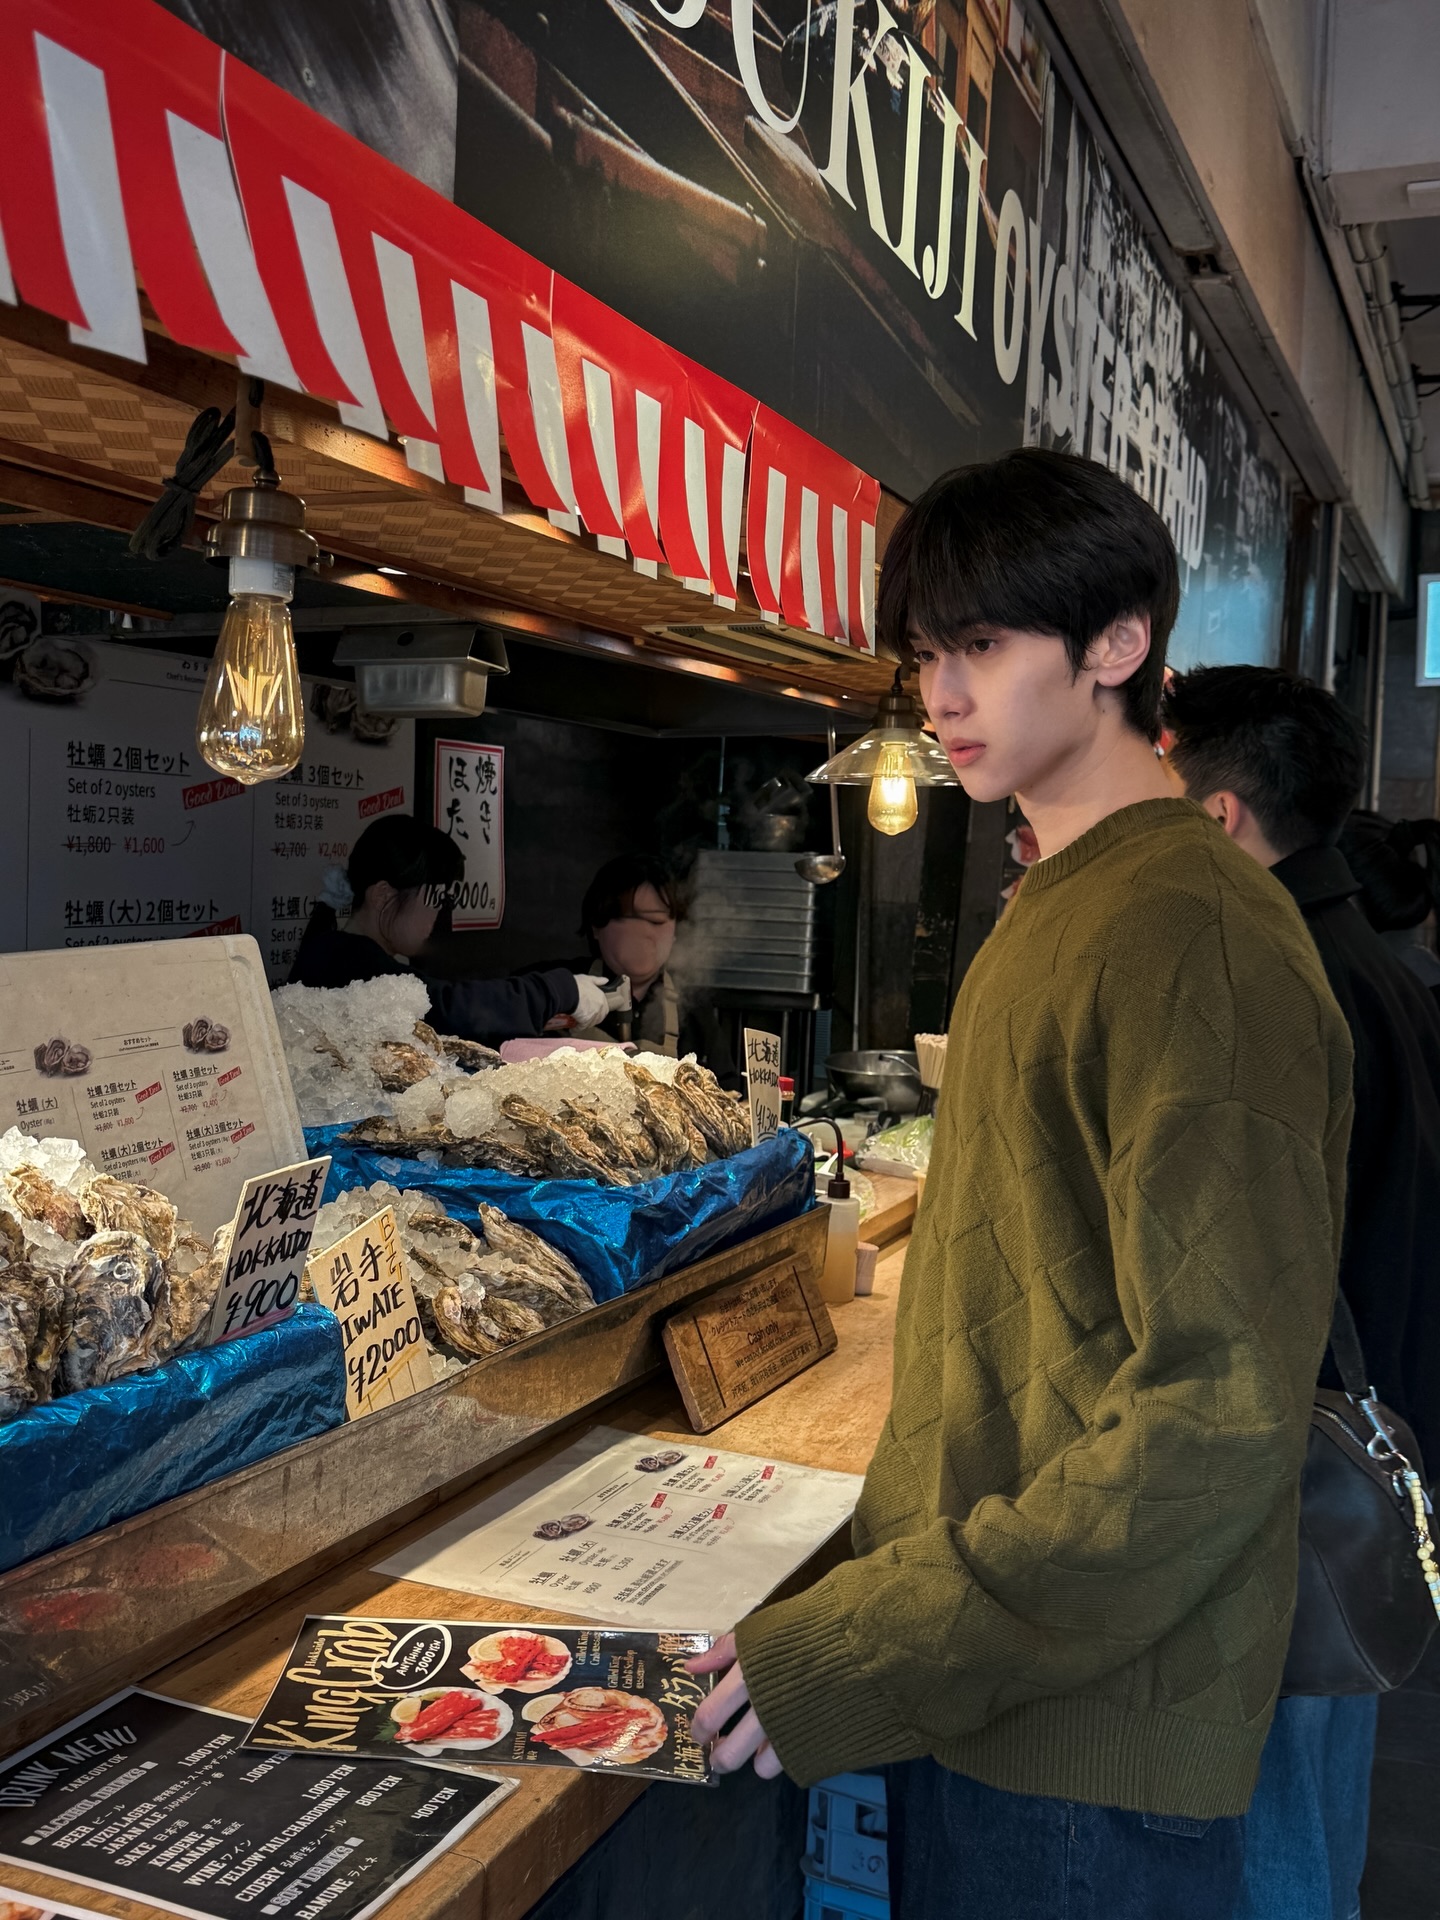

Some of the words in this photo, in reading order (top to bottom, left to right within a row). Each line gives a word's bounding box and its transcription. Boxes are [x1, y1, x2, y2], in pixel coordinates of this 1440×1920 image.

[67, 741, 105, 768] 牡蠣
[113, 746, 190, 773] 2個セット
[308, 765, 364, 787] 3個セット
[68, 778, 87, 794] Set
[91, 778, 103, 795] of
[105, 781, 112, 795] 2
[115, 783, 155, 800] oysters
[275, 792, 290, 807] Set
[292, 793, 301, 807] of
[303, 794, 308, 808] 3
[309, 796, 339, 811] oysters
[67, 804, 135, 825] 牡蛎2只装
[67, 836, 111, 856] ¥1,800
[124, 837, 165, 856] ¥1,600
[318, 842, 348, 860] ¥2,400
[748, 1038, 779, 1067] 北海道
[21, 1119, 42, 1131] Oyster
[239, 1166, 324, 1241] 北海道
[226, 1228, 312, 1288] HOKKAIDO
[330, 1238, 384, 1311] 岩手
[223, 1271, 298, 1335] ¥900
[341, 1281, 405, 1351] IWATE
[748, 1327, 766, 1346] Cash
[765, 1320, 780, 1335] only
[348, 1317, 420, 1404] ¥2000
[286, 1622, 397, 1687] Crab
[304, 1638, 325, 1666] Hokkaido
[397, 1642, 424, 1676] ANYTHING
[576, 1646, 587, 1664] Grilled
[252, 1689, 408, 1751] King
[51, 1725, 139, 1777] MENU
[60, 1775, 94, 1792] TAKE
[88, 1762, 113, 1776] OUT
[108, 1754, 128, 1763] OK
[35, 1799, 102, 1838] ALCOHOL
[91, 1768, 146, 1799] DRINKS
[52, 1826, 94, 1848] BEER
[92, 1804, 125, 1824] ビール
[178, 1749, 212, 1766] 1,000
[204, 1734, 234, 1748] YEN
[82, 1826, 120, 1847] YUZU
[113, 1803, 156, 1827] LAGER
[103, 1827, 146, 1854] JAPAN
[140, 1812, 167, 1828] ALE
[115, 1842, 156, 1866] SAKE
[153, 1820, 189, 1841] 日本酒
[240, 1764, 274, 1782] 1,000
[184, 1860, 226, 1885] WINE
[220, 1840, 251, 1860] ワイン
[302, 1780, 335, 1799] 1,000
[326, 1765, 356, 1780] YEN
[215, 1852, 266, 1886] YELLOW
[258, 1837, 290, 1852] TAIL
[282, 1788, 350, 1836] CHARDONNAY
[149, 1832, 204, 1866] KINOENE
[167, 1837, 223, 1873] INANAMI
[235, 1867, 284, 1902] CIDERY
[356, 1791, 382, 1806] 800
[373, 1776, 402, 1791] YEN
[296, 1878, 353, 1920] RAMUNE
[348, 1858, 377, 1876] ラムネ
[411, 1804, 438, 1818] 400
[429, 1788, 458, 1804] YEN
[270, 1879, 311, 1906] SOFT
[300, 1846, 353, 1882] DRINKS
